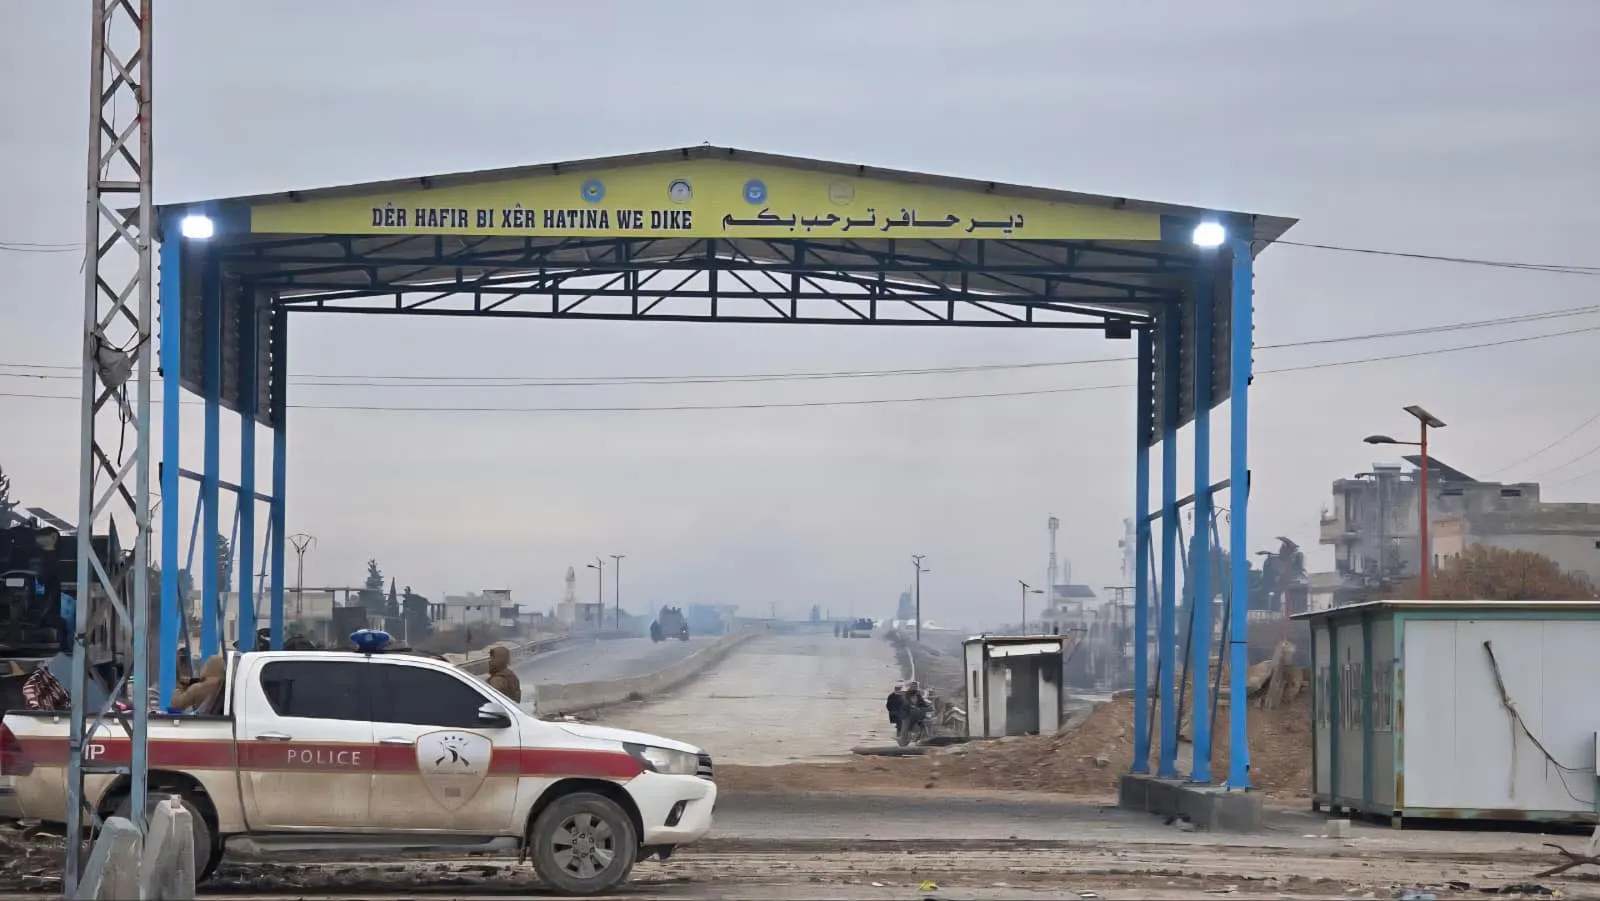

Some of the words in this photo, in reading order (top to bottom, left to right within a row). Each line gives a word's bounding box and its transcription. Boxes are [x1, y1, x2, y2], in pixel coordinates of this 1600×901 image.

[371, 201, 407, 227] DÊR
[414, 208, 469, 228] HAFIR
[476, 208, 494, 228] BI
[501, 203, 536, 229] XÊR
[543, 209, 610, 229] HATINA
[616, 209, 644, 230] WE
[650, 210, 692, 230] DIKE
[722, 207, 797, 233] بكم
[800, 207, 876, 233] ترحب
[880, 207, 961, 233] حافر
[965, 212, 1024, 234] دير
[286, 749, 362, 766] POLICE
